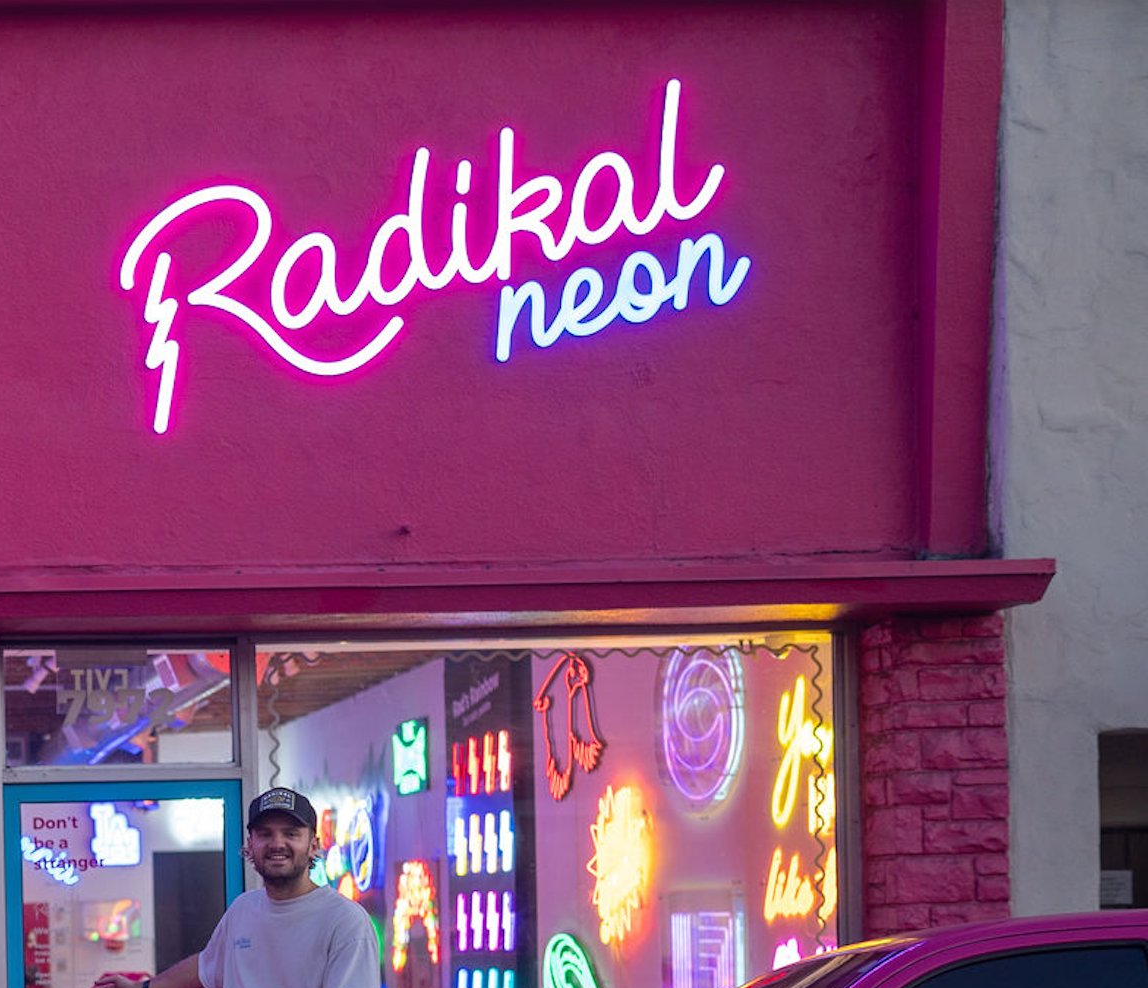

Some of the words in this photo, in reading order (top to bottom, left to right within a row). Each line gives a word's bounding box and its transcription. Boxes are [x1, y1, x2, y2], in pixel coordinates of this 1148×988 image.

[120, 78, 724, 434] Radikal
[495, 232, 750, 362] neon
[33, 816, 78, 830] Don't
[34, 837, 54, 849] be
[59, 839, 68, 849] a
